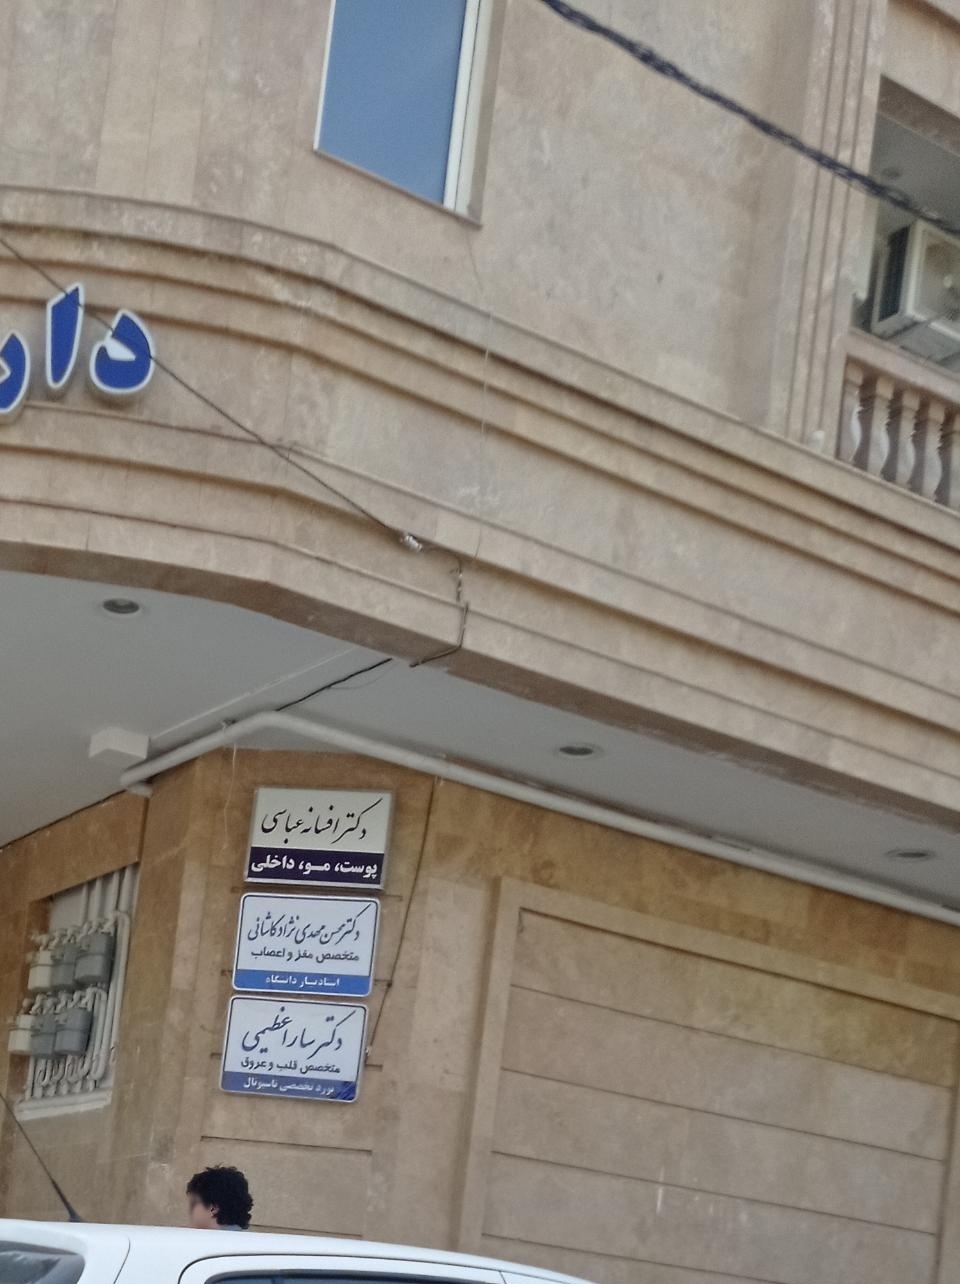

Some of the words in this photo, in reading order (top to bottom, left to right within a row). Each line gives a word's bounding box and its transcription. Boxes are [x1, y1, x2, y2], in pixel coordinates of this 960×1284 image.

[261, 809, 304, 844] عباسی
[300, 804, 340, 835] افسانه
[331, 798, 382, 844] دکتر
[251, 854, 295, 872] داخلی
[334, 861, 378, 879] پوست،
[247, 911, 286, 941] کاشانی
[276, 914, 300, 938] نژاد
[334, 903, 372, 945] دکتر
[319, 923, 346, 945] محسن
[250, 946, 285, 960] اعصاب
[286, 951, 293, 962] و
[294, 949, 314, 962] مغز
[315, 950, 360, 964] متخصص
[241, 1006, 294, 1053] عظیمی
[282, 1027, 316, 1048] سارا
[307, 1009, 357, 1060] دکتر
[241, 1057, 267, 1071] عروق
[268, 1060, 274, 1071] و
[276, 1059, 297, 1071] قلب
[300, 1062, 341, 1075] متخصص
